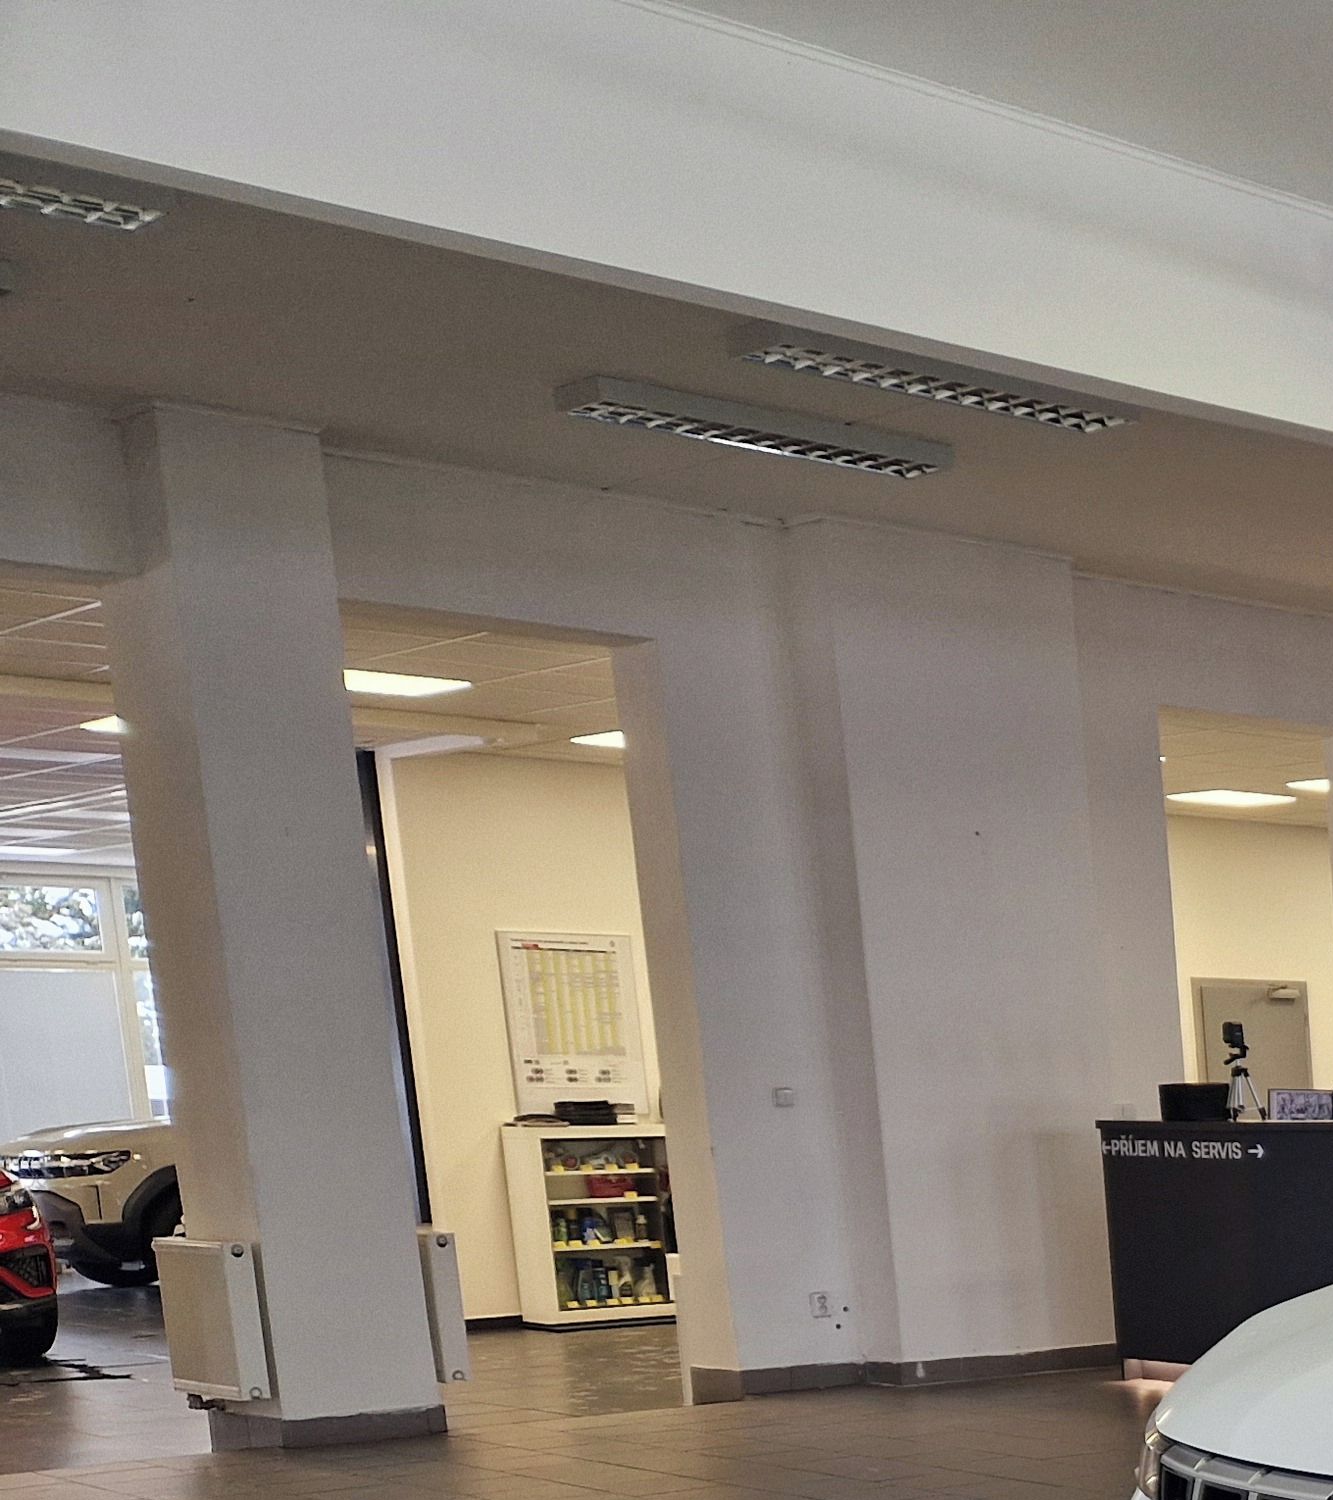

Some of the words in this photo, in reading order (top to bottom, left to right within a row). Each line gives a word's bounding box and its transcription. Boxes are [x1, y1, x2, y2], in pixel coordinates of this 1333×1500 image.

[1111, 1135, 1160, 1158] PŘÍJEM
[1163, 1140, 1187, 1158] NA
[1191, 1140, 1242, 1160] SERVIS
